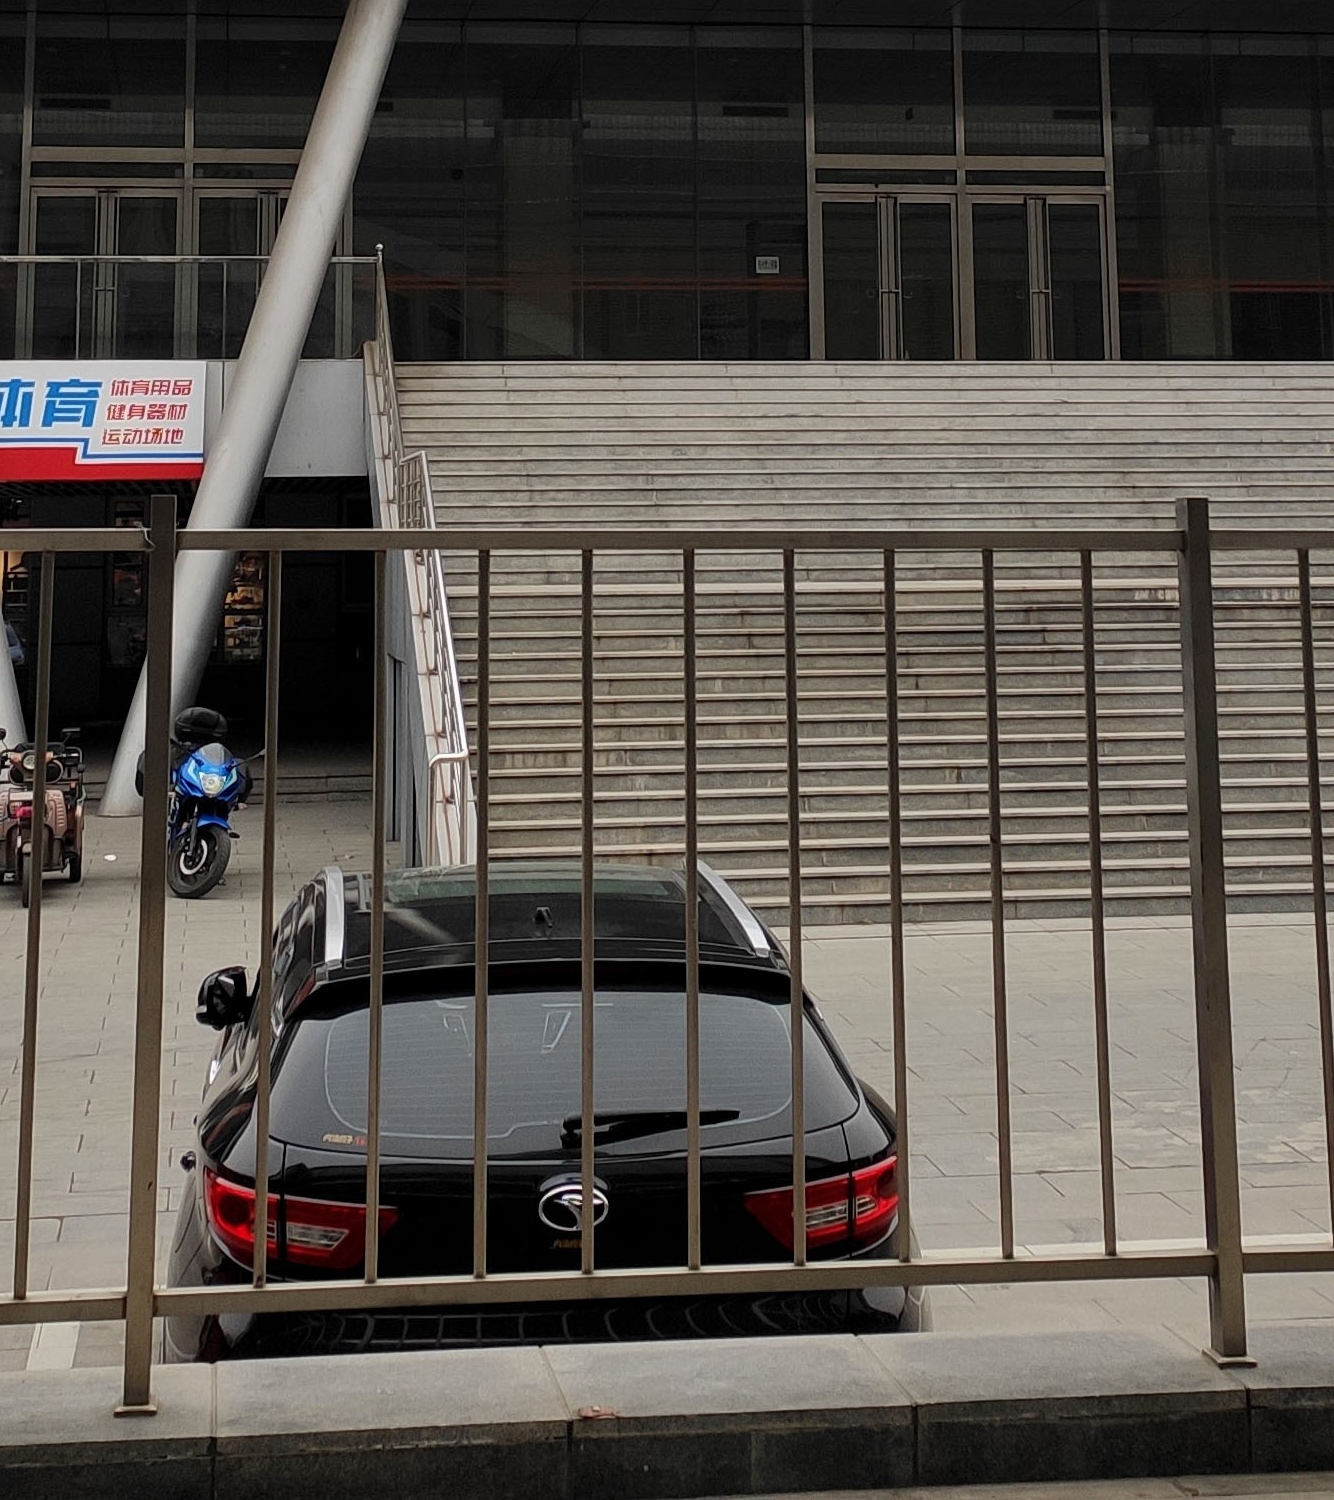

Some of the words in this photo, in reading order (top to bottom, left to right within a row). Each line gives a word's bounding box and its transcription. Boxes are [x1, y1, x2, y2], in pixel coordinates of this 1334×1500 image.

[110, 379, 193, 397] 体育用品
[106, 403, 189, 421] 健身器材
[101, 427, 185, 446] 运动场地
